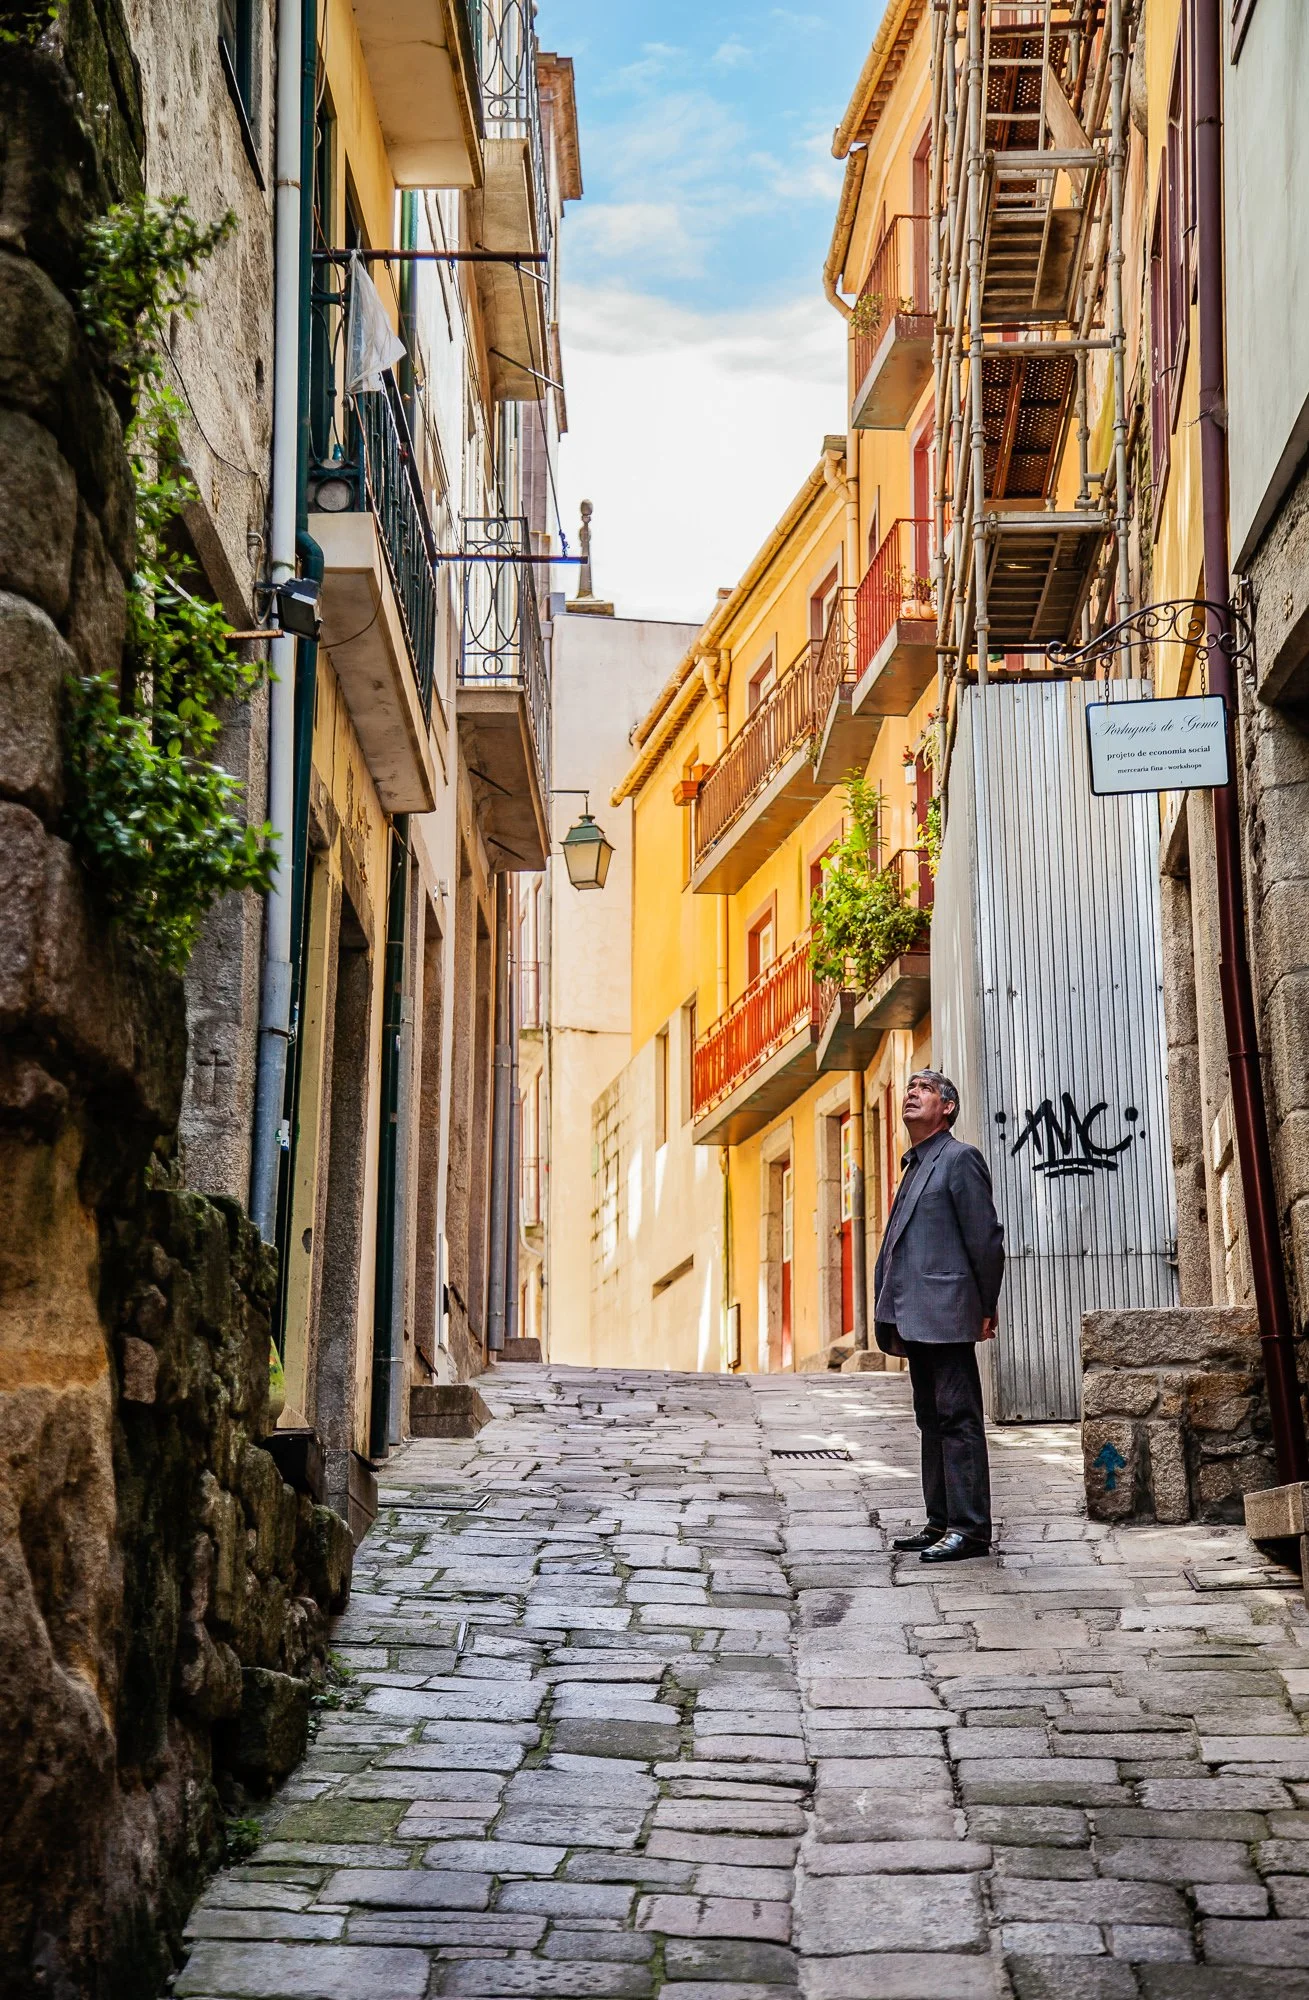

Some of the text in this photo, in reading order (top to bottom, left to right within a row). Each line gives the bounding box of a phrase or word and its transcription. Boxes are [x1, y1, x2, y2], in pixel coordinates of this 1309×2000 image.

[1095, 714, 1219, 740] Português de Gema
[1106, 745, 1211, 761] projeto de economia social
[1117, 765, 1149, 774] mercearia
[1150, 764, 1163, 772] fina
[1168, 762, 1202, 771] workshops
